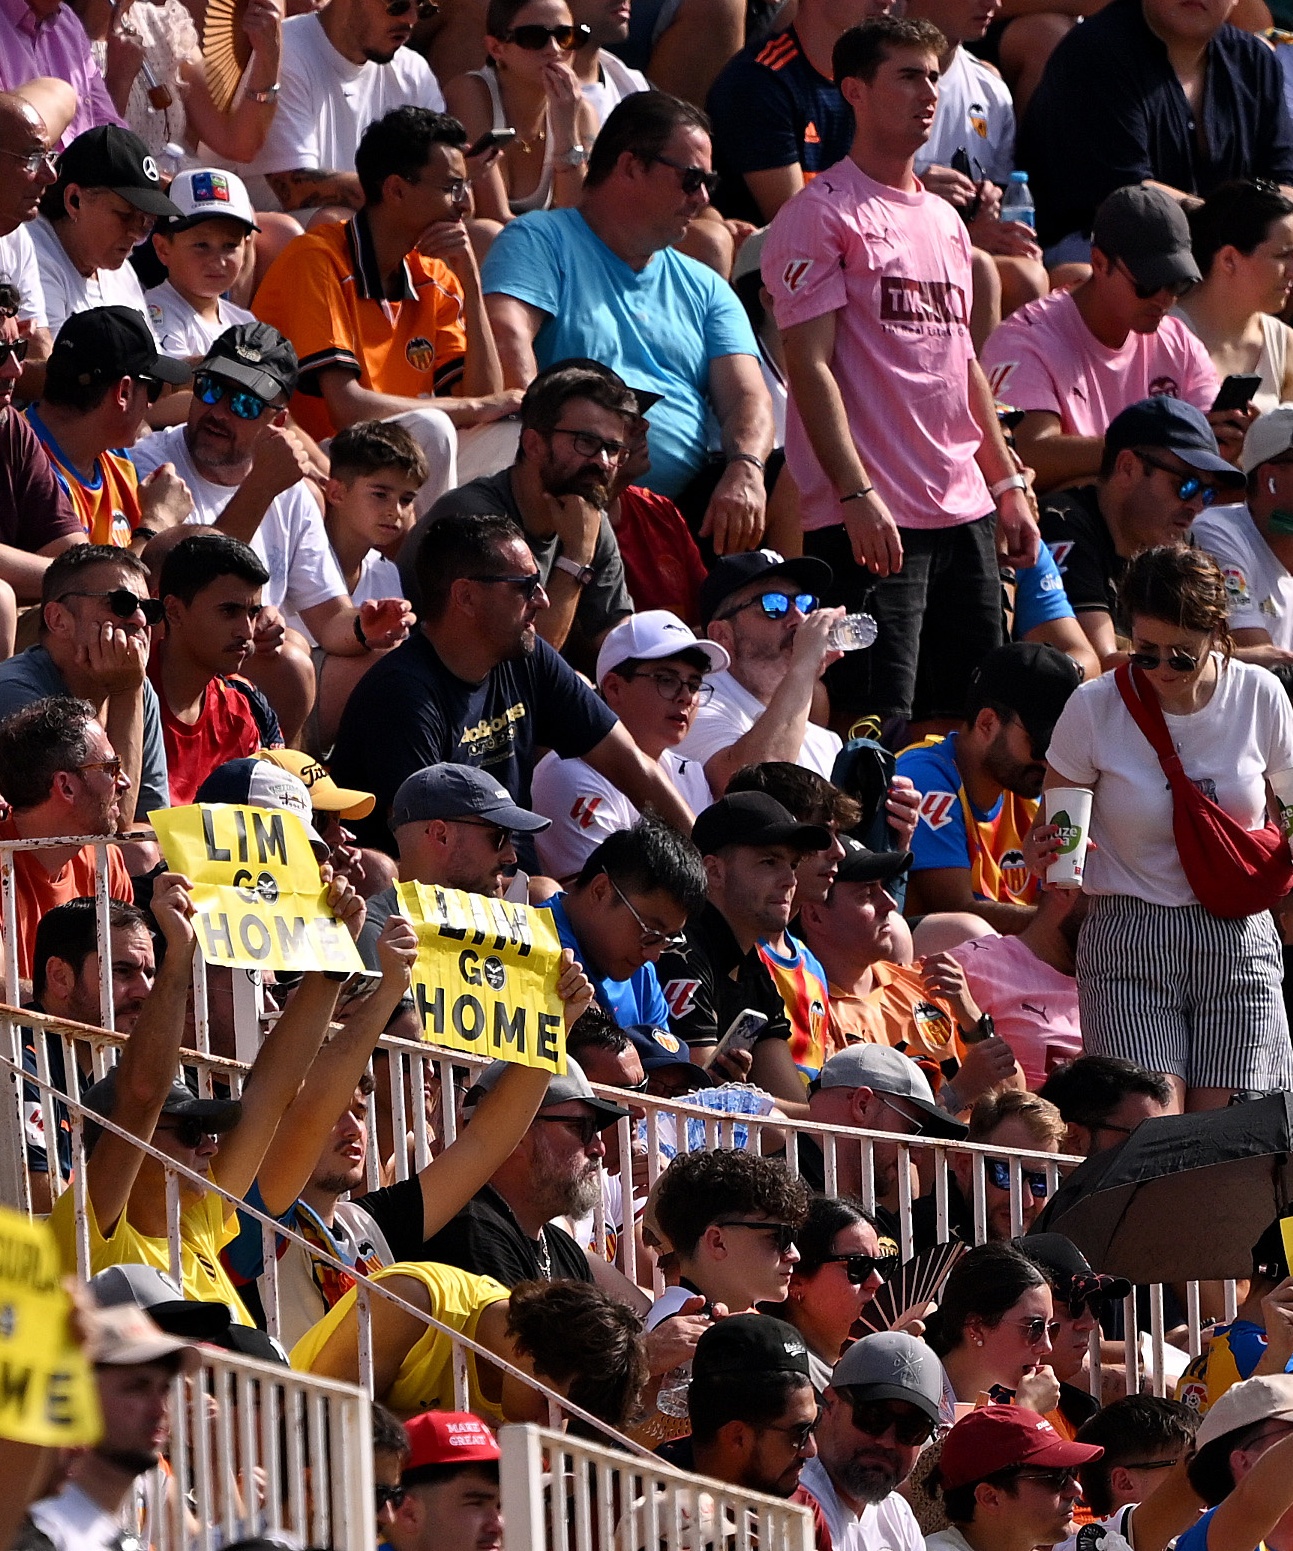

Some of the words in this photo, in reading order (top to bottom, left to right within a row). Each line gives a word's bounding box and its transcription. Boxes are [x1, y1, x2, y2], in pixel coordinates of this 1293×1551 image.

[201, 809, 289, 866] LIM
[202, 910, 350, 963] HOME
[458, 949, 506, 992] GO
[417, 983, 564, 1062] HOME
[446, 1422, 482, 1434] MAKE
[448, 1435, 486, 1446] GREAT
